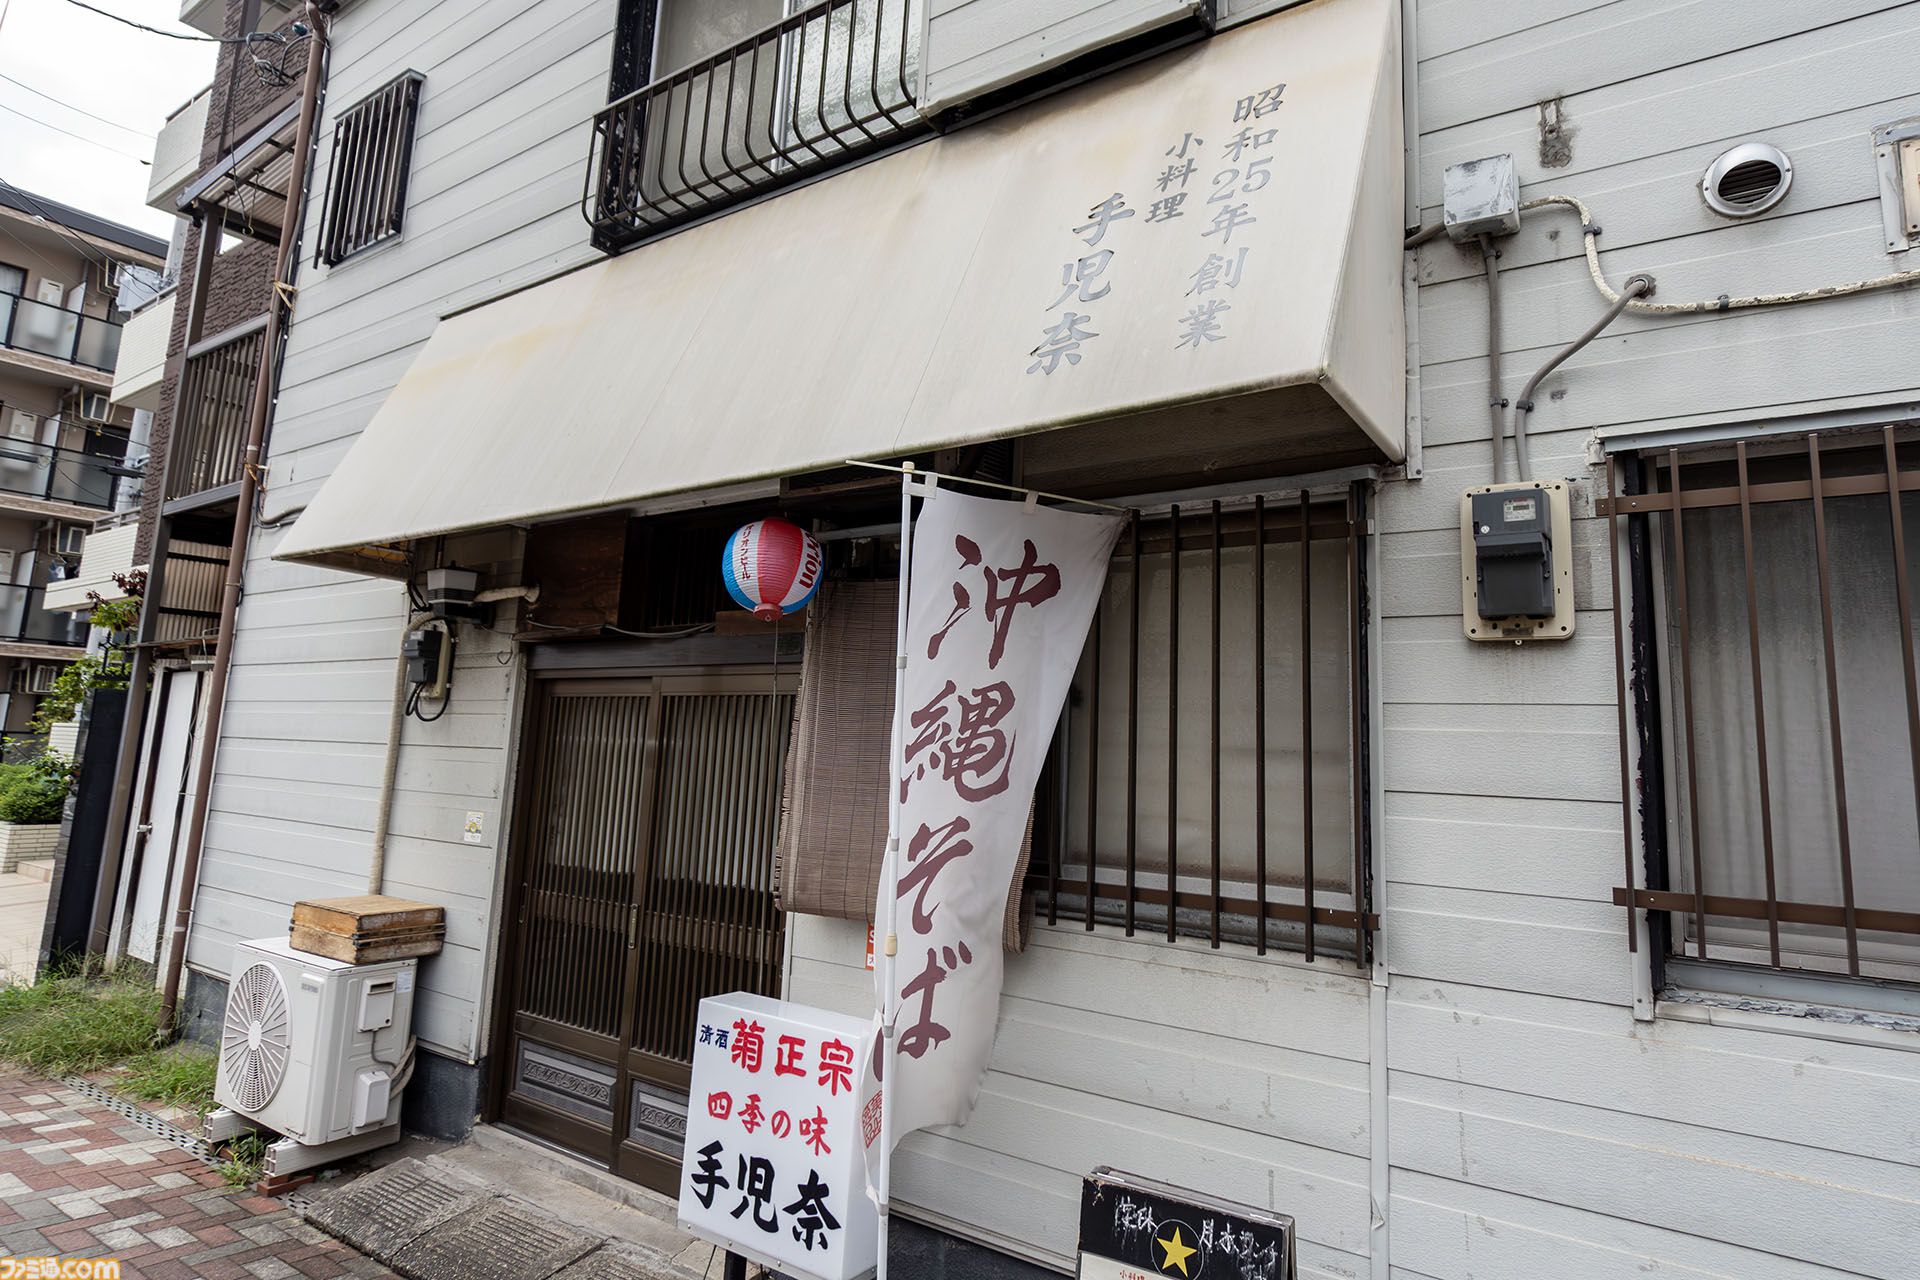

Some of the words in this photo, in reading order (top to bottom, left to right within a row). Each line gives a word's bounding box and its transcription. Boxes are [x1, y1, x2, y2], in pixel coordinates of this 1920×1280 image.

[1144, 132, 1204, 223] 小料理
[1174, 83, 1287, 350] 昭和25年創業
[1026, 192, 1136, 376] 手児奈
[740, 524, 754, 580] オリオンビール
[872, 534, 1061, 1082] 沖縄そば
[699, 1024, 730, 1050] 清酒
[731, 1017, 854, 1096] 菊正宗
[707, 1091, 832, 1156] 四季の味
[690, 1139, 842, 1251] 手児奈
